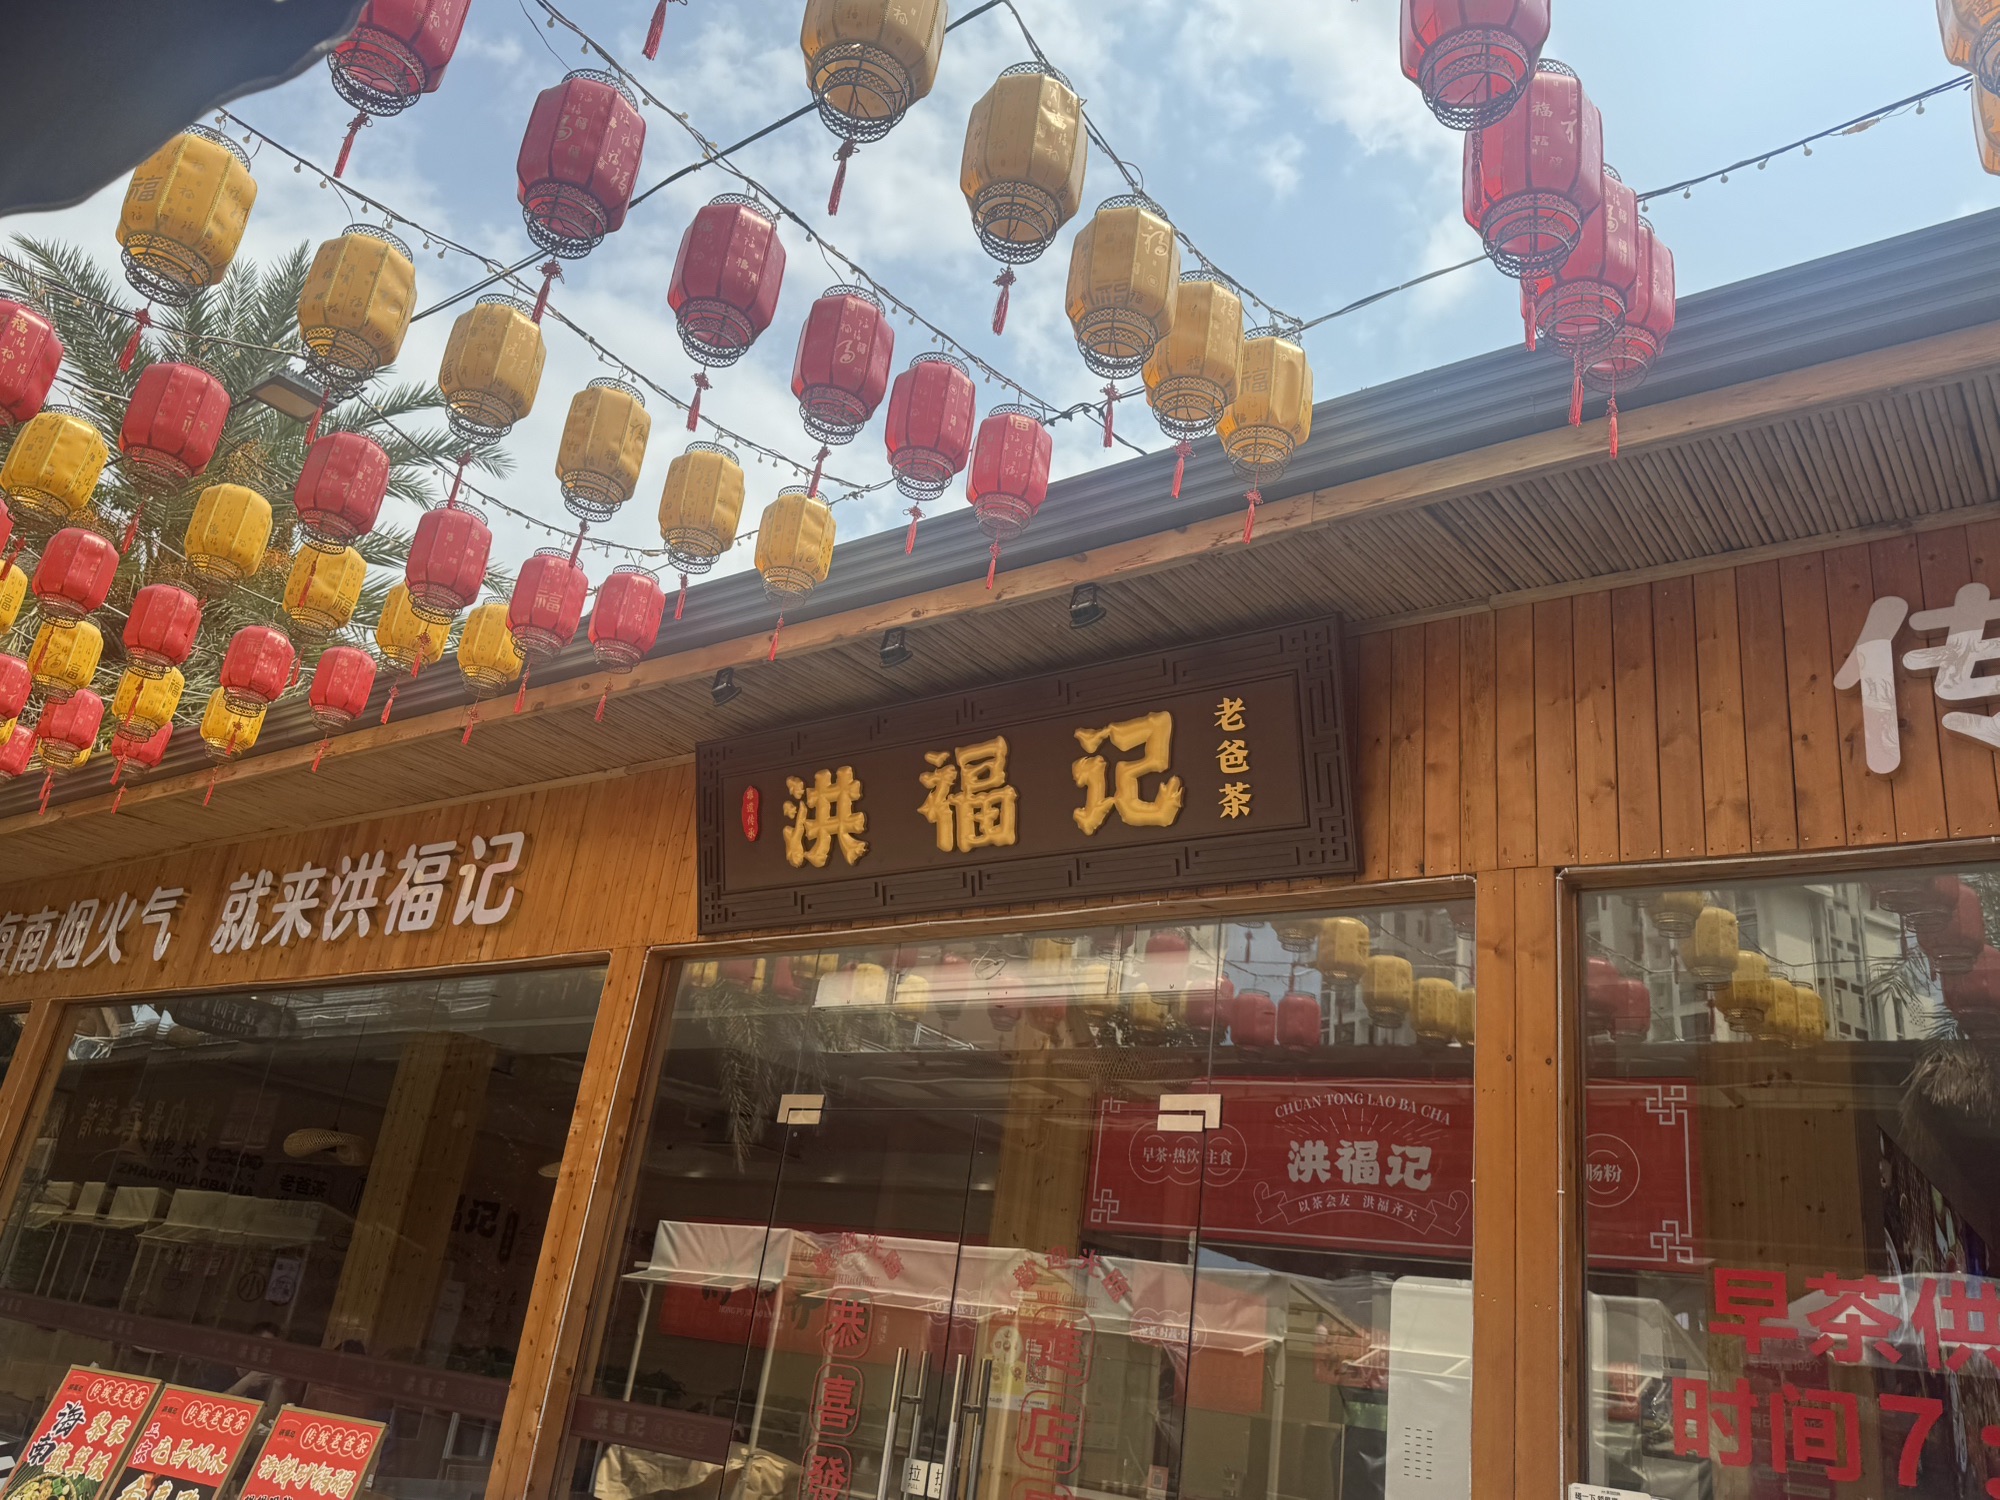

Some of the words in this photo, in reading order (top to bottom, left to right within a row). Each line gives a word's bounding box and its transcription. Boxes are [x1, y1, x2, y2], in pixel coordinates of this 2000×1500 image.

[1214, 697, 1252, 819] 老爸茶
[783, 711, 1183, 868] 洪福记
[210, 831, 525, 954] 就来洪福记
[1275, 1095, 1321, 1119] CHUAN
[1323, 1091, 1364, 1106] TONG
[1367, 1093, 1395, 1108] LAO
[1398, 1098, 1417, 1114] BA
[1420, 1104, 1451, 1126] CHA
[1287, 1139, 1432, 1192] 洪福记
[1298, 1194, 1350, 1213] 以茶会友
[1362, 1194, 1418, 1223] 洪福齐天
[90, 1383, 147, 1405] 传统老爸茶
[85, 1411, 131, 1447] 黎家
[185, 1404, 248, 1431] 传统老爸茶
[303, 1427, 370, 1454] 传统老爸茶
[908, 1463, 922, 1482] 拉
